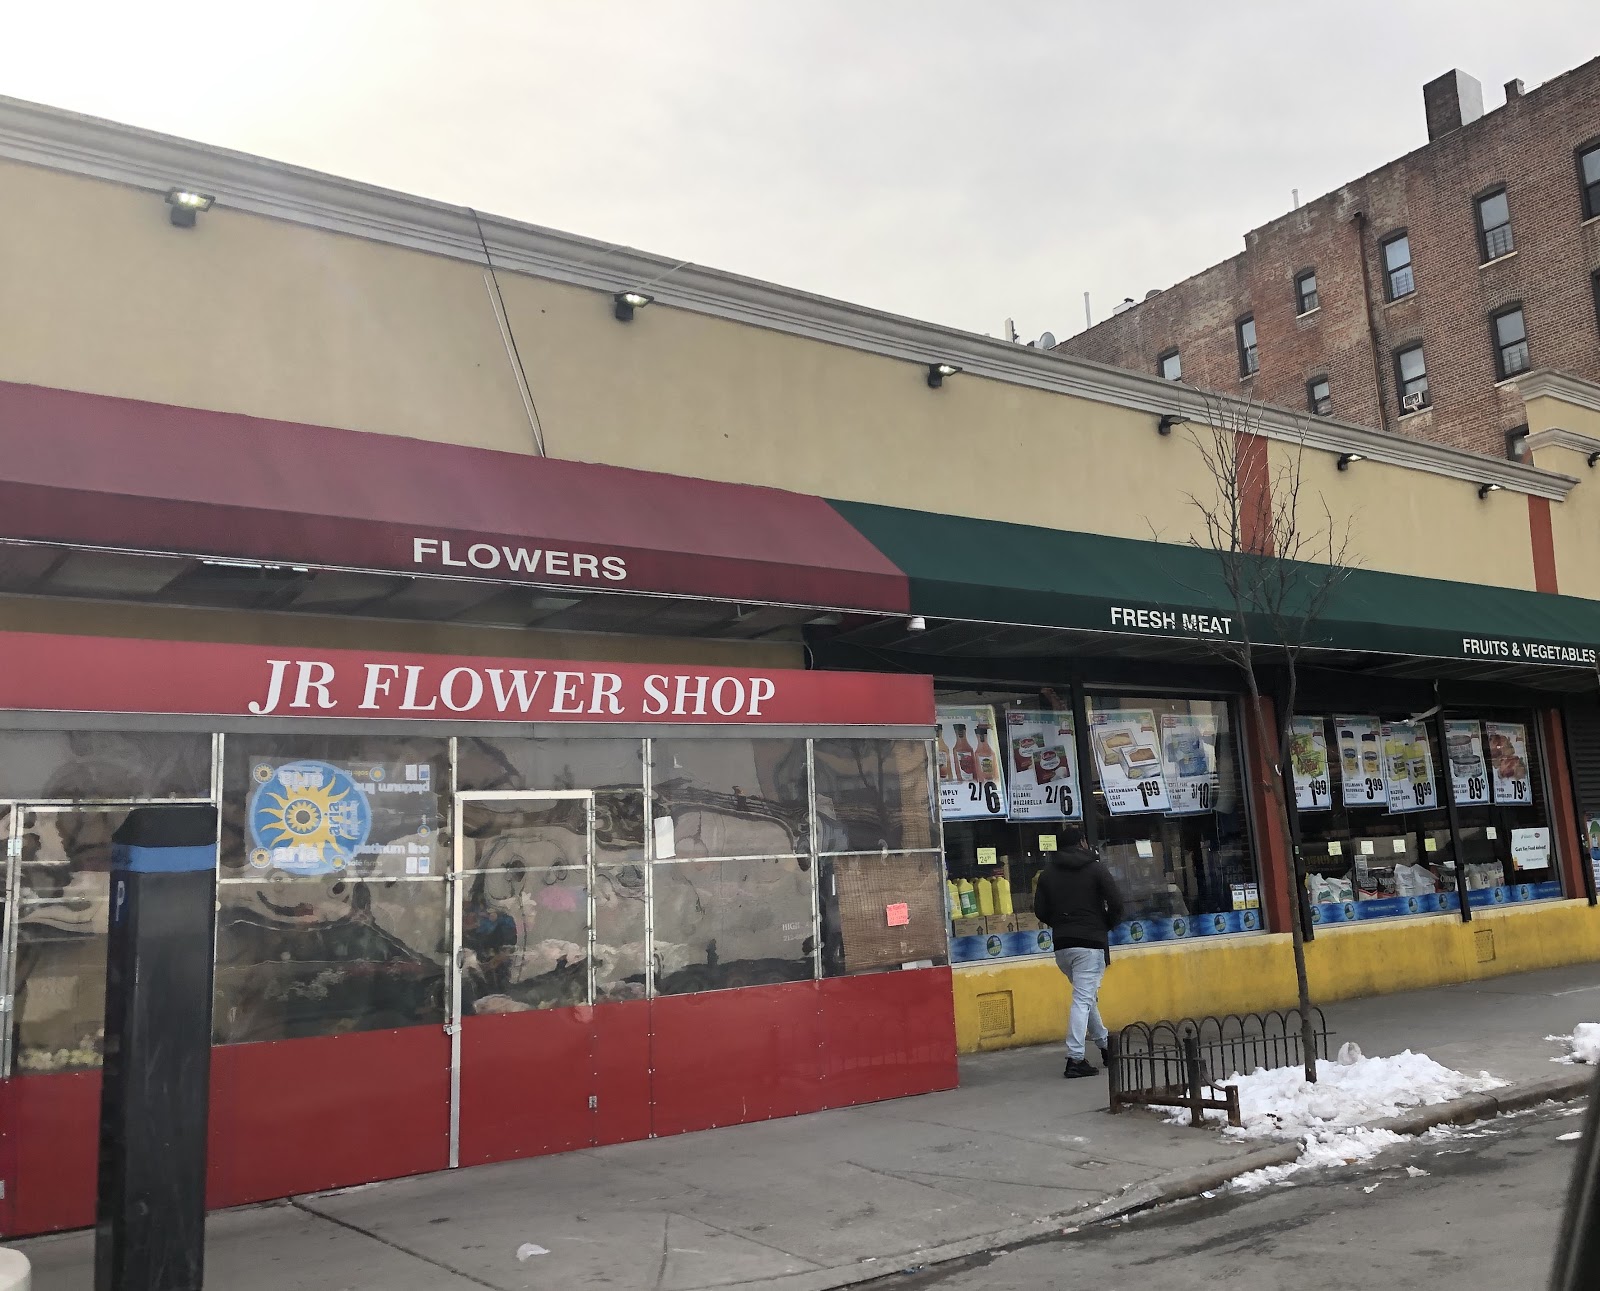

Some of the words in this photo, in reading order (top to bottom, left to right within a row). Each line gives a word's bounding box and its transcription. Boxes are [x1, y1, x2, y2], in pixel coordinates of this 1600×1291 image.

[413, 537, 627, 581] FLOWERS
[1110, 607, 1176, 630] FRESH
[1182, 613, 1231, 635] MEAT
[1463, 638, 1509, 656] FRUITS
[1512, 642, 1521, 657] &
[1523, 643, 1596, 663] VEGETABLES
[248, 659, 338, 715] JR
[358, 664, 626, 714] FLOWER
[642, 674, 776, 716] SHOP
